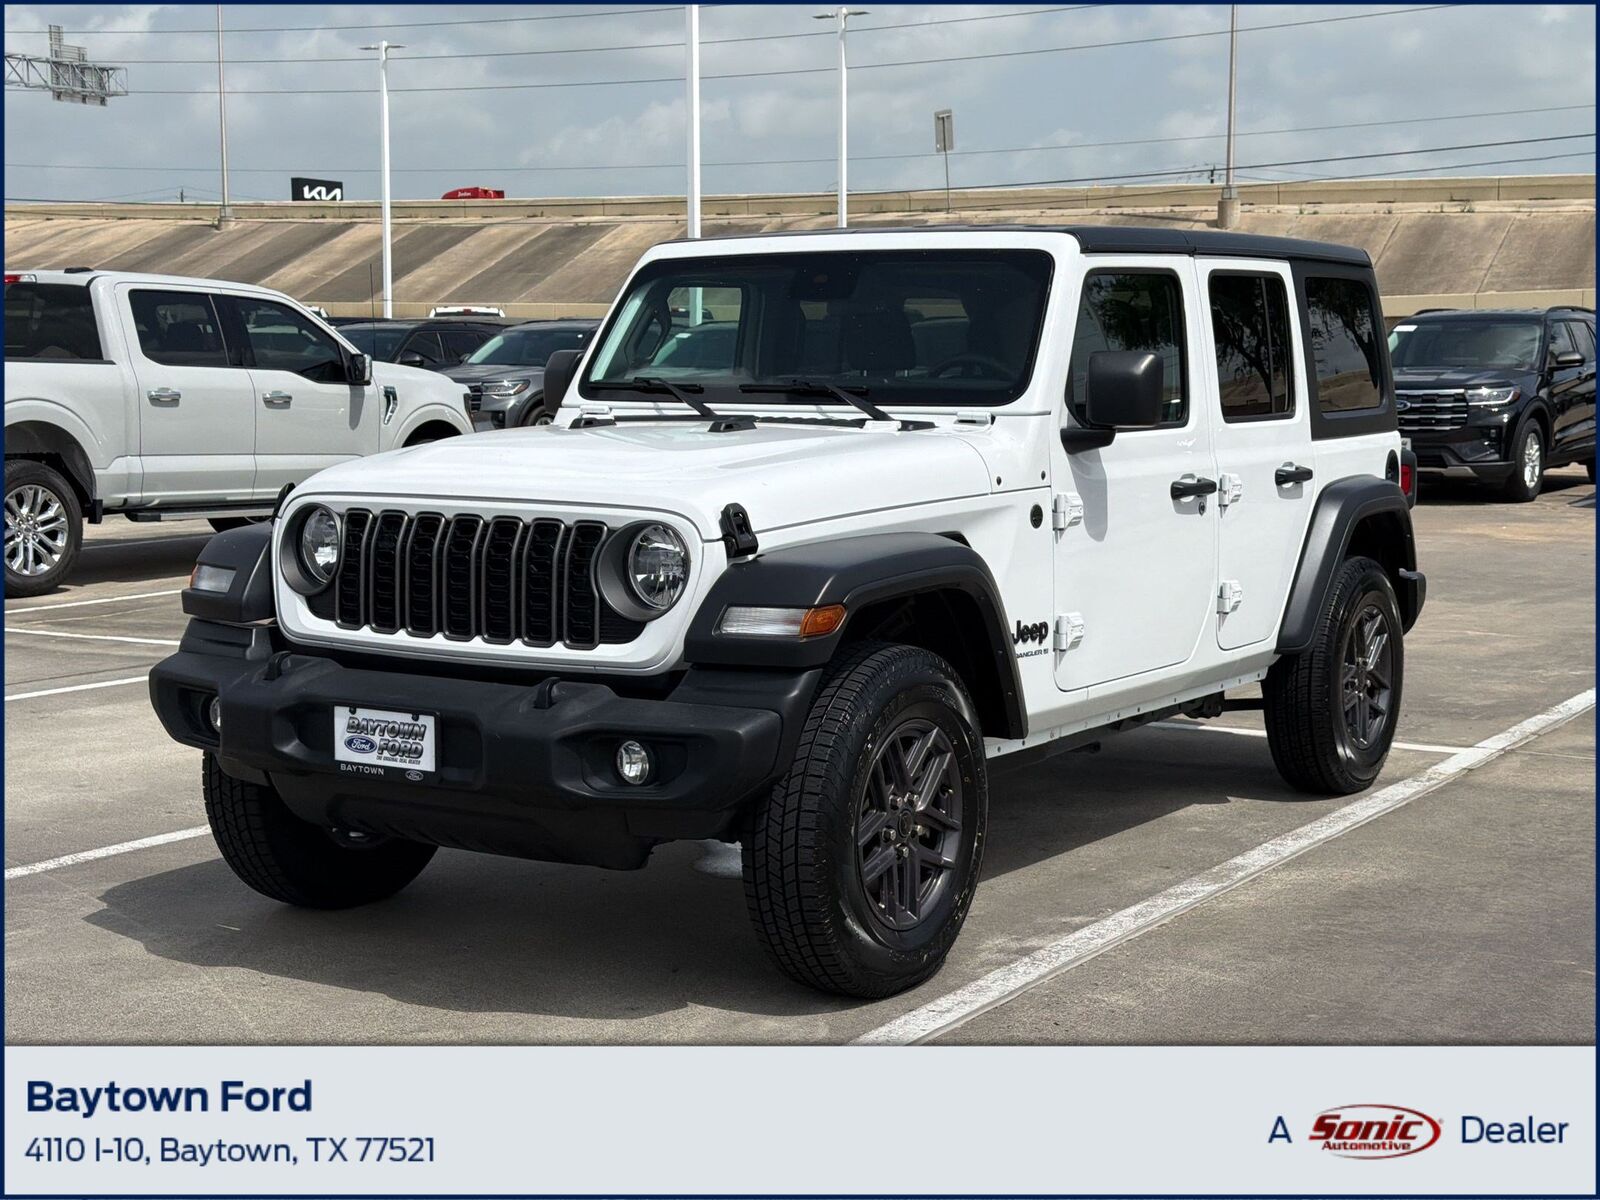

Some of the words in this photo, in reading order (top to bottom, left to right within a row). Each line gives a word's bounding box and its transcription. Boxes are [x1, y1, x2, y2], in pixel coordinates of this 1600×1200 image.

[1011, 620, 1048, 645] Jeep
[346, 716, 426, 741] BAYTOWN
[351, 740, 371, 751] Ford
[377, 738, 424, 759] FORD
[340, 763, 384, 775] BAYTOWN
